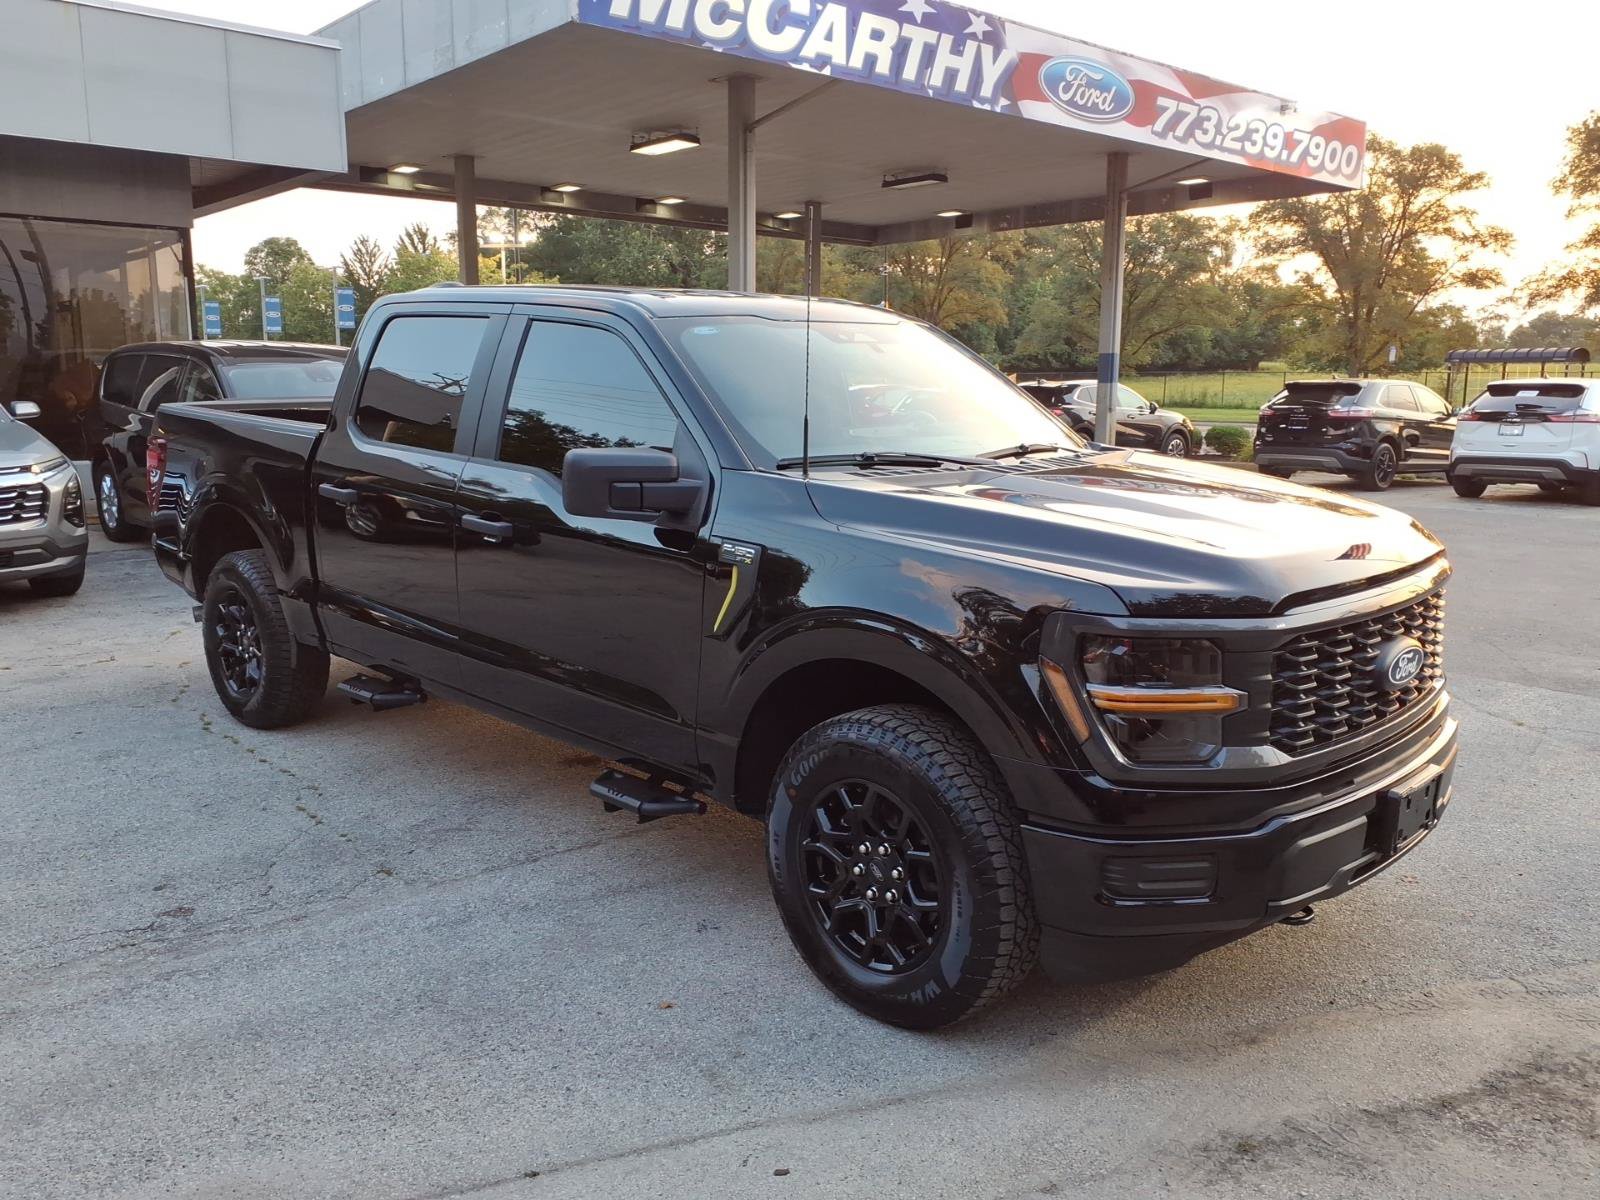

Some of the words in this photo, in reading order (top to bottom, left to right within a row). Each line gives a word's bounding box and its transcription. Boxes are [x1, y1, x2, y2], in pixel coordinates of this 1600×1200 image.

[1058, 64, 1117, 112] Ford
[1152, 96, 1359, 175] 773.239.7900
[1395, 651, 1419, 680] Ford
